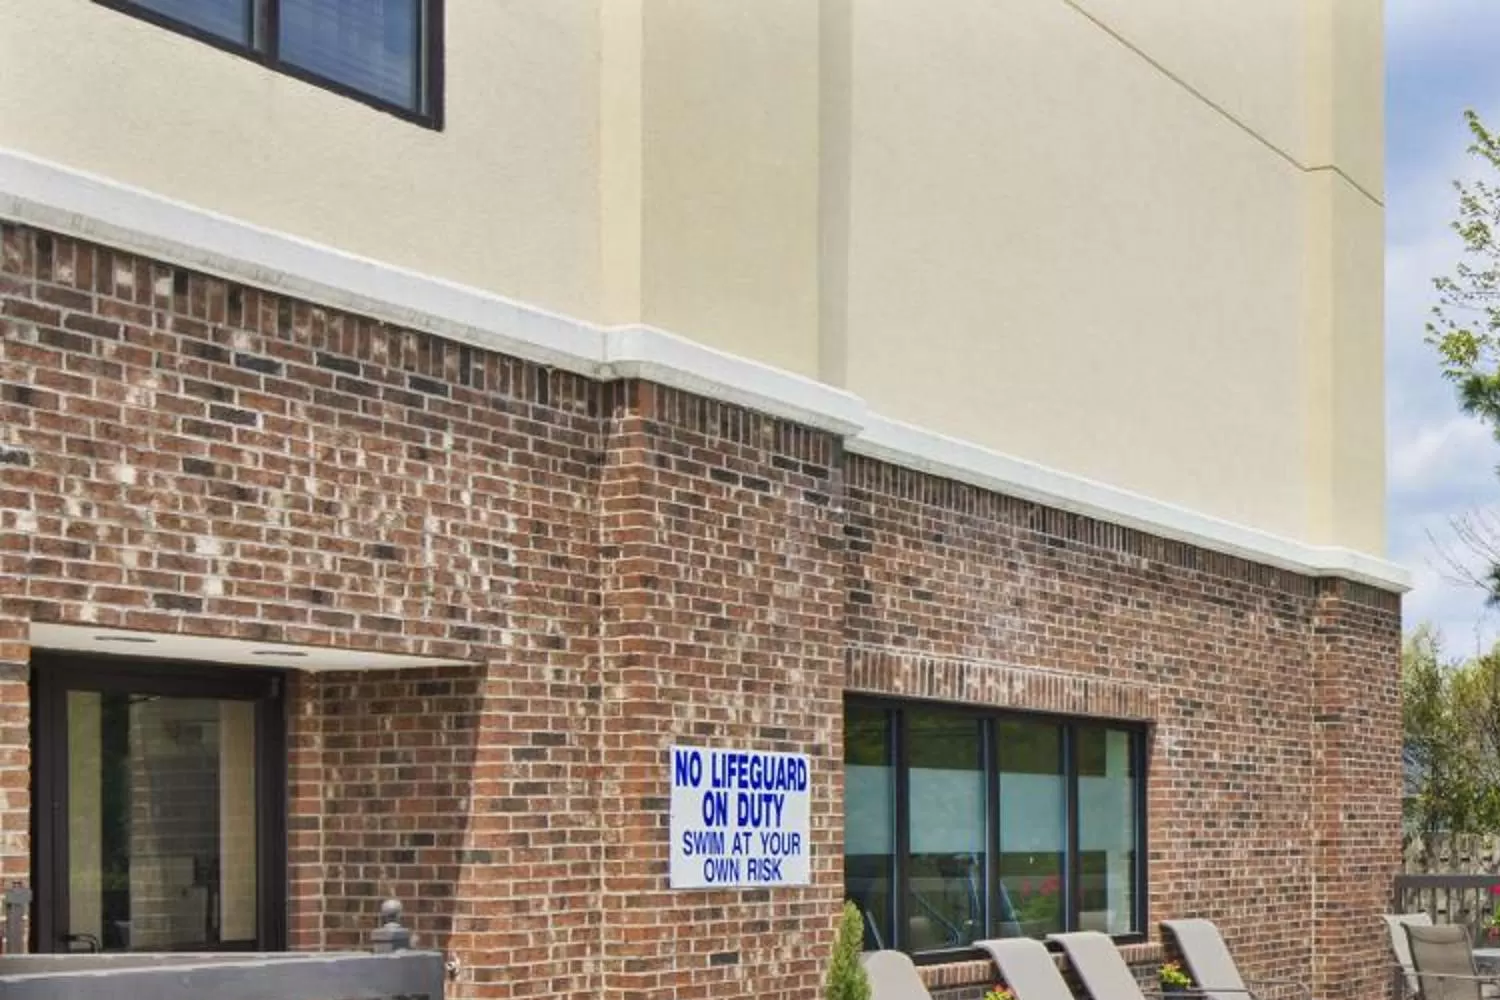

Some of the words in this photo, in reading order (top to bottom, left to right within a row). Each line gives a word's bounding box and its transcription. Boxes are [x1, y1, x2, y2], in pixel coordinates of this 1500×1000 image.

[675, 751, 702, 788] NO
[711, 752, 807, 791] LIFEGUARD
[702, 791, 728, 827] ON
[737, 792, 785, 828] DUTY
[682, 831, 725, 855] SWIM
[731, 831, 752, 855] AT
[760, 832, 801, 855] YOUR
[703, 858, 740, 882] OWN
[747, 858, 783, 881] RISK
